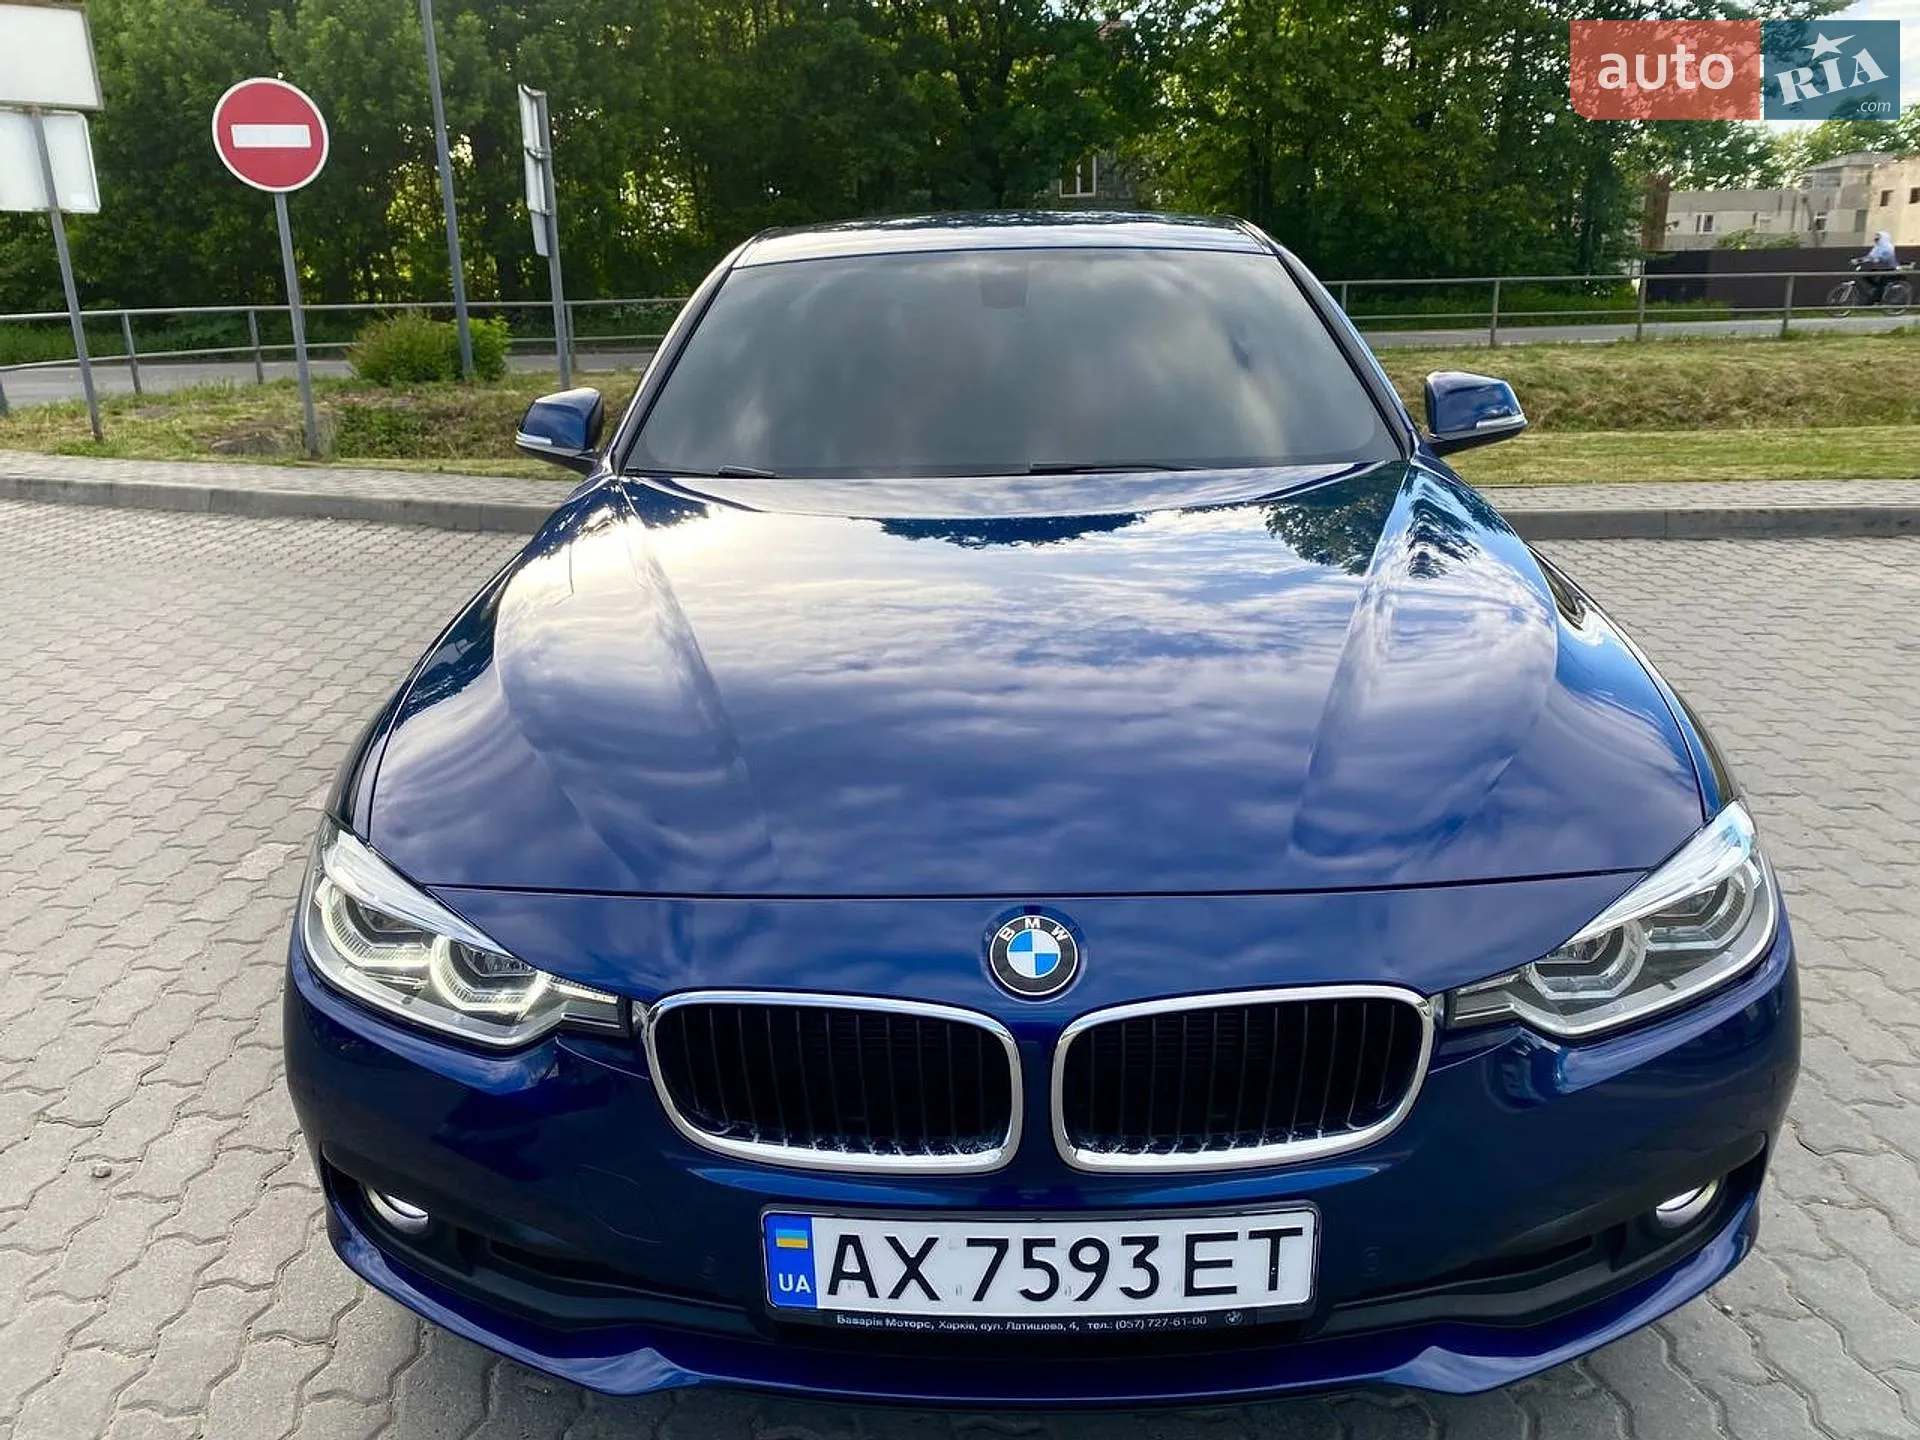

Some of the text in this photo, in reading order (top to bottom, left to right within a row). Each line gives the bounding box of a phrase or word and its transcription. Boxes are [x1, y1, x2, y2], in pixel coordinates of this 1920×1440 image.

[999, 917, 1068, 941] BMW
[827, 1226, 1304, 1302] AX 7593 ET
[778, 1272, 812, 1294] UA
